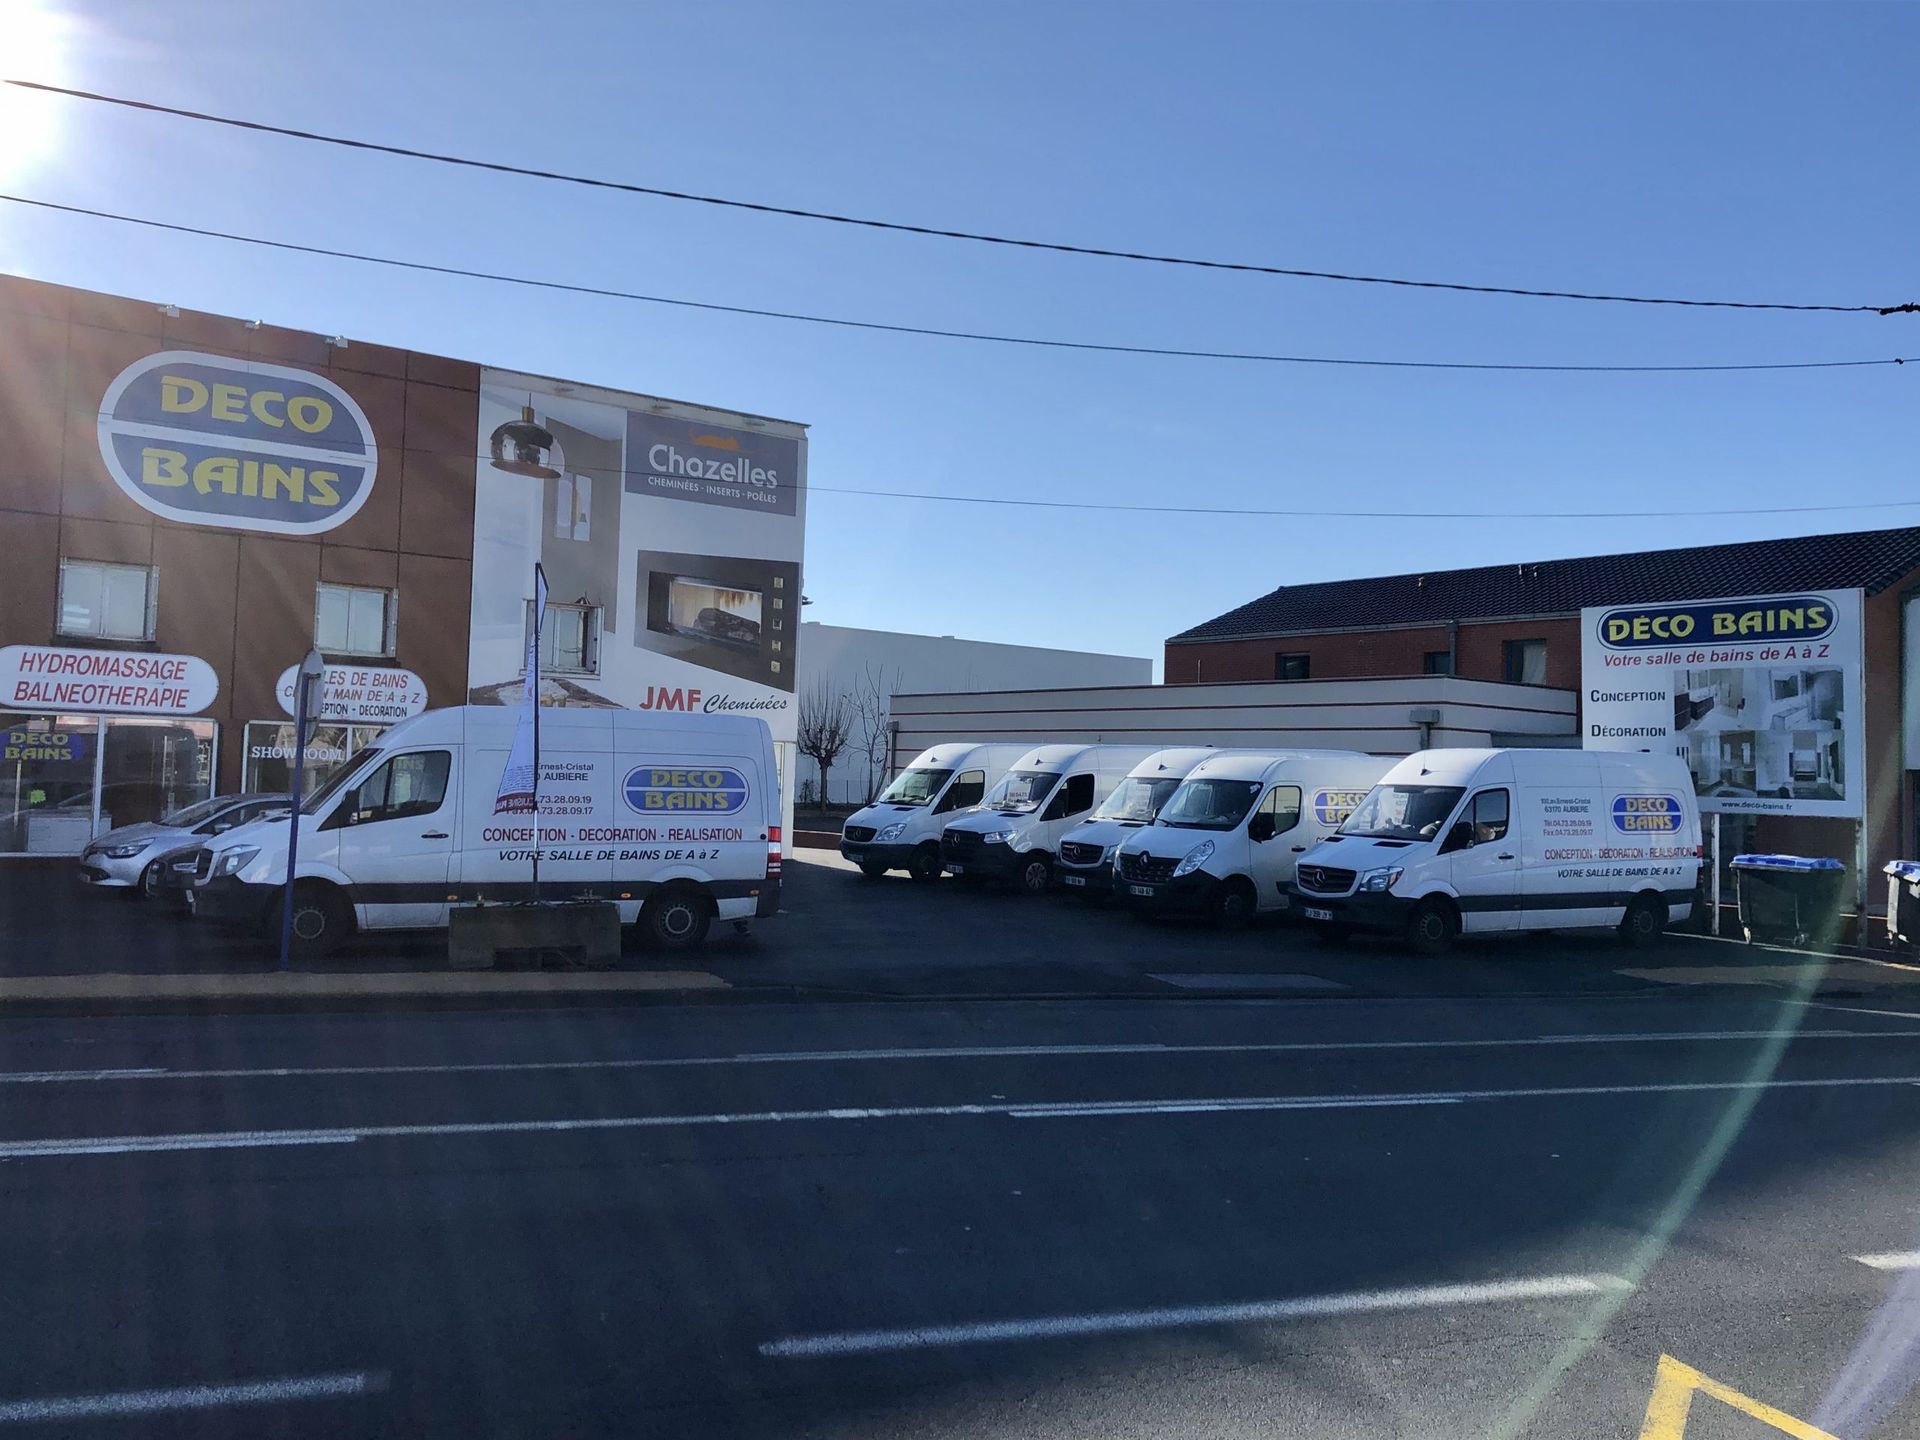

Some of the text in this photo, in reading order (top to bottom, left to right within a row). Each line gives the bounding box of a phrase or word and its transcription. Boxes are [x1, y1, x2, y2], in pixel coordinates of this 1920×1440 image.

[161, 376, 332, 433] DECO
[649, 444, 777, 489] Chazelles
[142, 448, 340, 506] BAINS
[648, 476, 699, 492] CHEMINÉES
[706, 485, 740, 498] INSERTS
[1608, 606, 1828, 642] DÉCO BAINS
[1604, 645, 1830, 667] Votre salle de bains de A à Z
[19, 652, 188, 680] HYDROMASSAGE
[351, 672, 369, 686] DE
[372, 673, 409, 689] BAINS
[14, 681, 190, 708] BALNEOTHERAPIE
[333, 688, 362, 701] MAIN
[367, 690, 383, 701] DE
[386, 692, 395, 703] A
[411, 693, 421, 704] Z
[639, 686, 788, 714] JMF Cheminées
[359, 705, 408, 718] DECORATION
[10, 732, 69, 745] DECO
[4, 747, 72, 761] BAINS
[544, 772, 589, 781] AUBIERE
[651, 769, 723, 788] DECO
[645, 790, 729, 810] BAINS
[1625, 798, 1668, 812] DECO
[1624, 816, 1673, 830] BAINS
[579, 828, 657, 841] DECORATION
[669, 828, 743, 841] REALISATION
[549, 850, 594, 861] SALLE
[597, 850, 615, 861] DE
[619, 850, 660, 860] BAINS
[665, 850, 682, 860] DE
[686, 850, 695, 860] A
[699, 849, 706, 860] à
[710, 849, 720, 860] Z
[1545, 848, 1592, 860] CONCEPTION
[1599, 848, 1643, 859] DECORATION
[1650, 847, 1692, 858] REALISATION
[1558, 869, 1585, 878] VOTRE
[1587, 868, 1611, 877] SALLE
[1613, 868, 1623, 876] DE
[1625, 868, 1649, 876] BAINS
[1650, 867, 1661, 875] DE
[1663, 867, 1669, 875] A
[1676, 867, 1682, 875] Z
